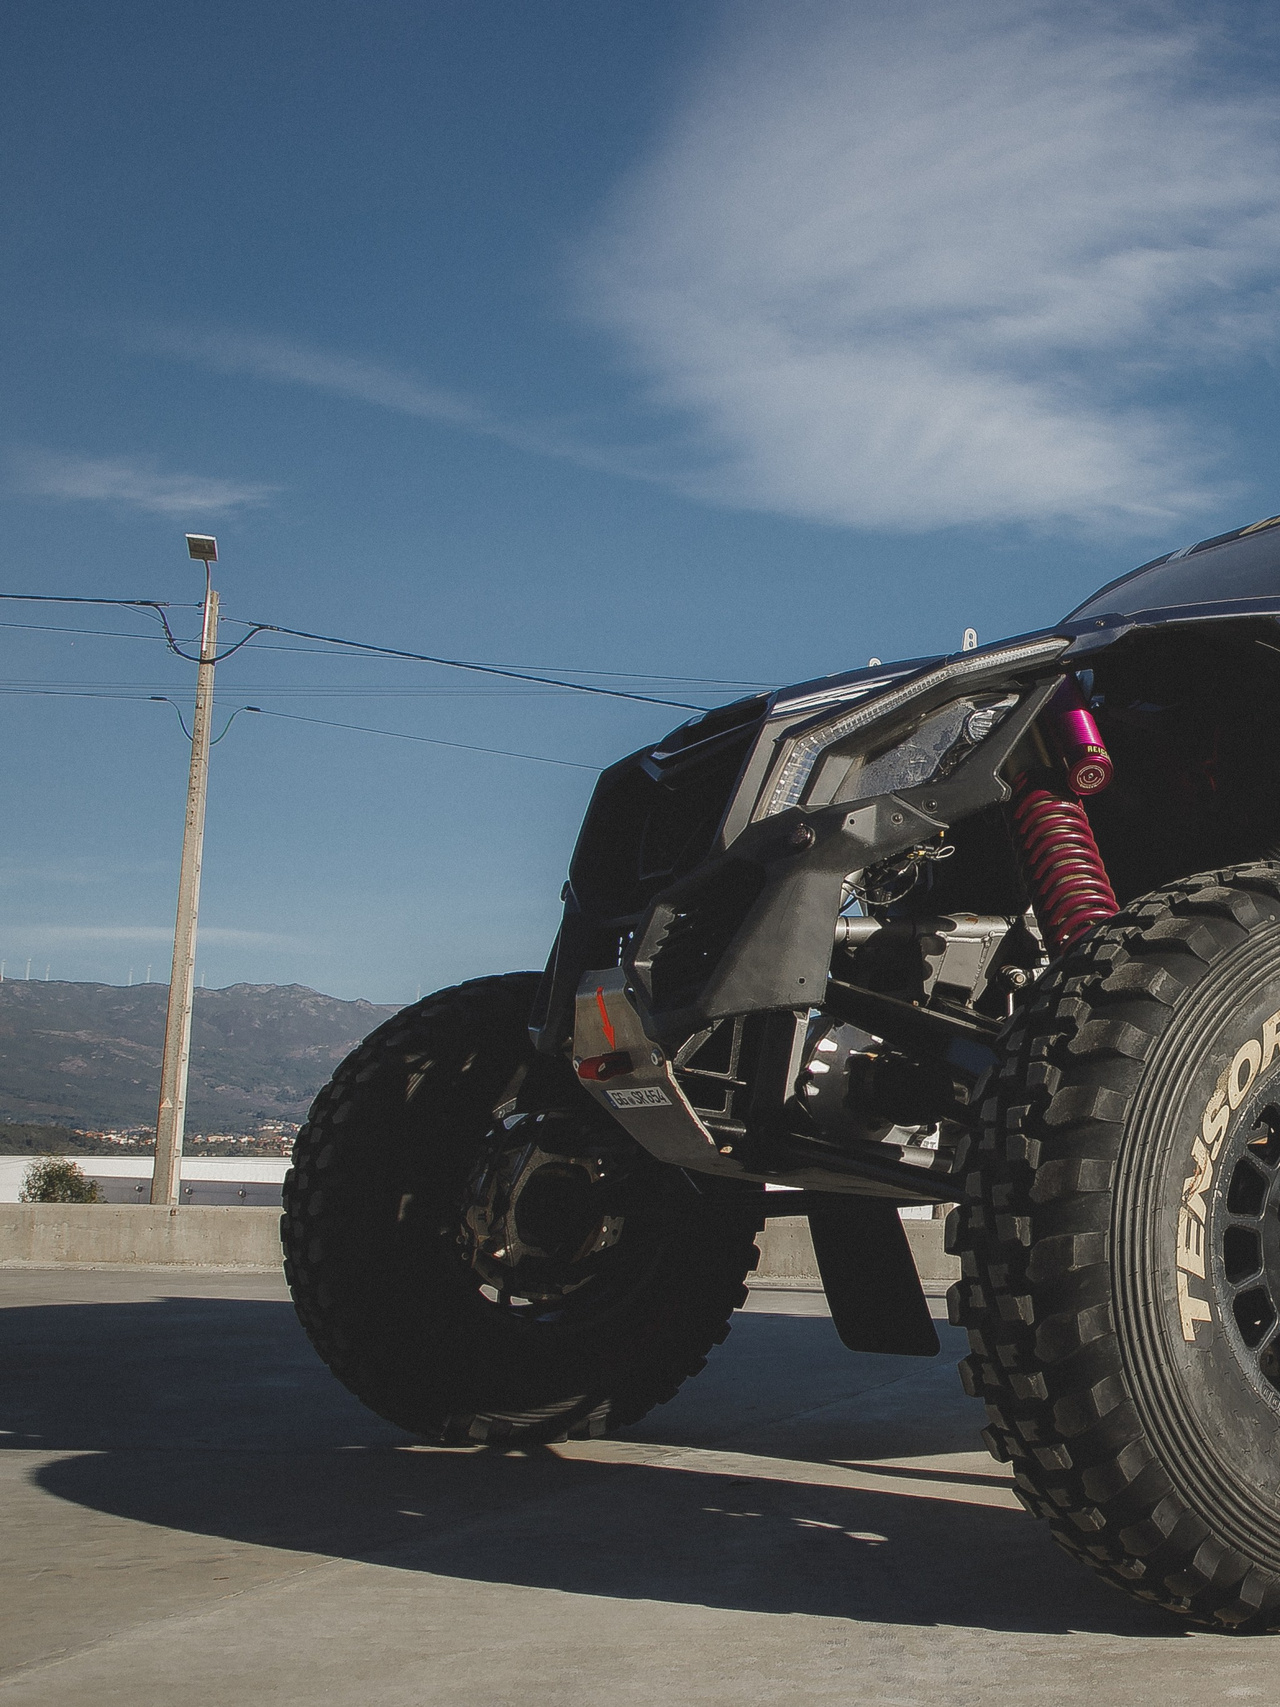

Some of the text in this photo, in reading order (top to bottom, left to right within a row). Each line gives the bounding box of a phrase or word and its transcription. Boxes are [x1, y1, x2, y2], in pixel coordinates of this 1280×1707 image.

[611, 1089, 667, 1106] GG SR 654
